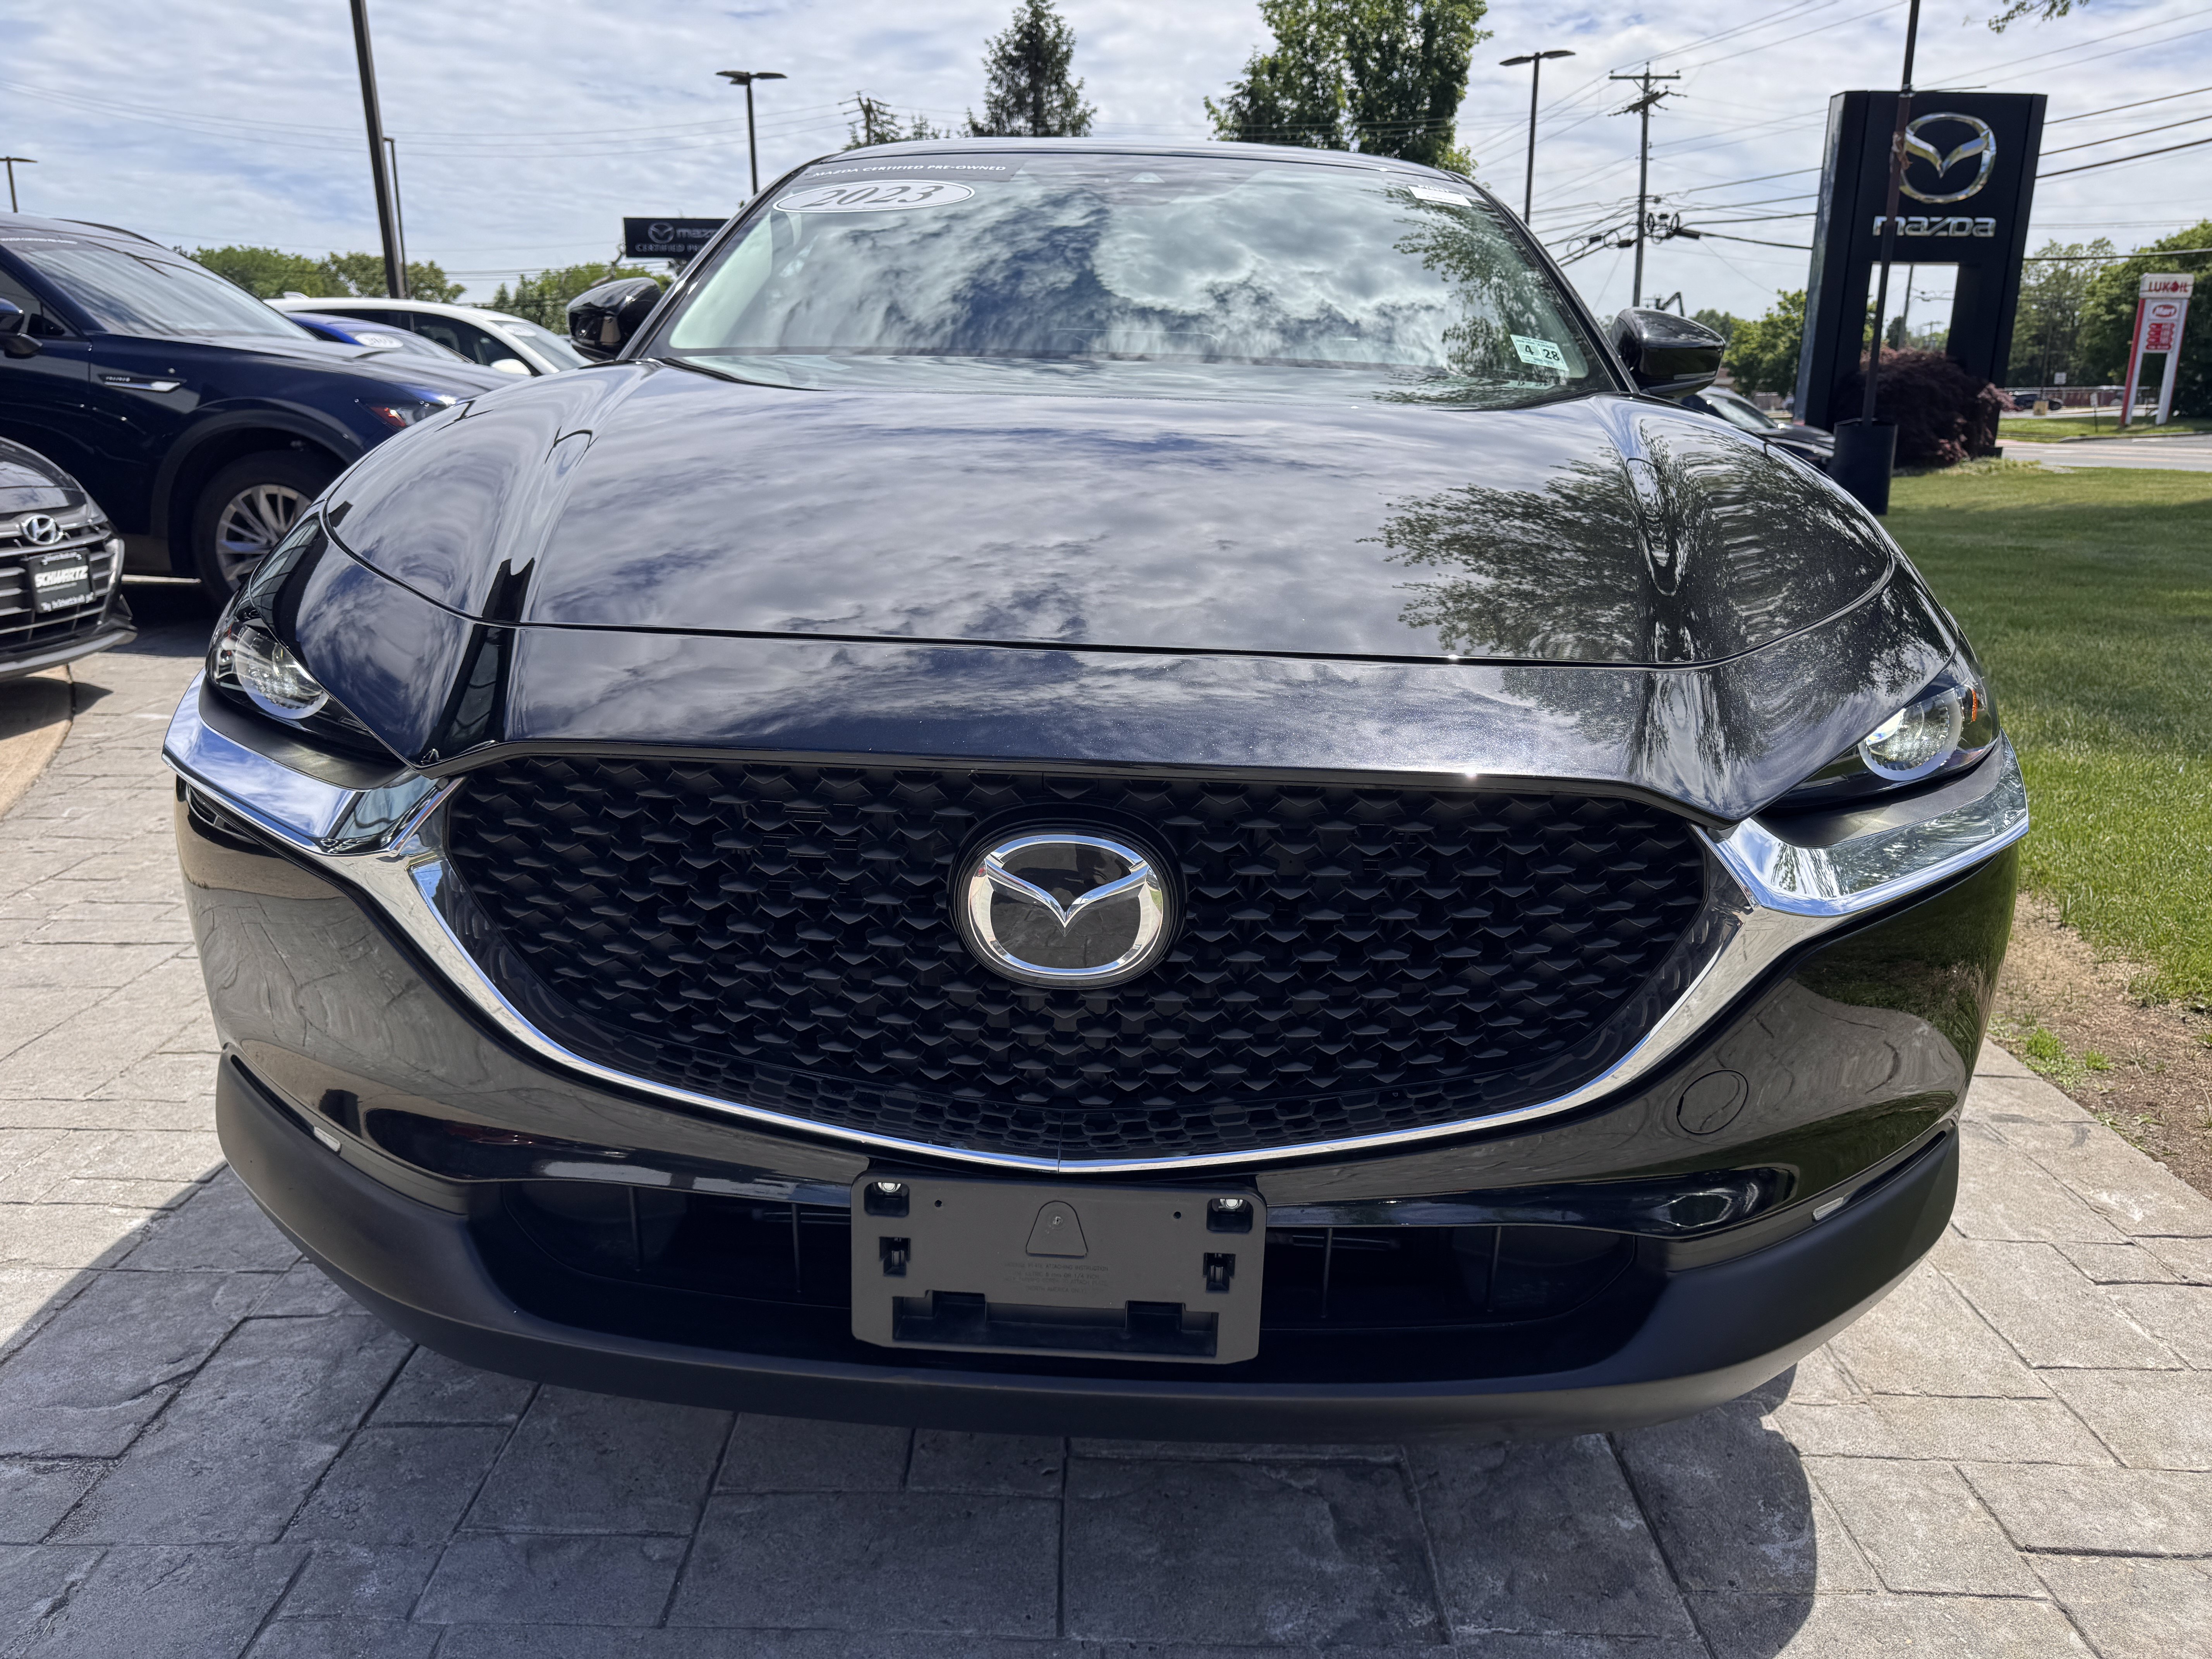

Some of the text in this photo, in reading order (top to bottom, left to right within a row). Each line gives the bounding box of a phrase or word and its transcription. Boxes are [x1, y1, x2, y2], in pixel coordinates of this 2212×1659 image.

[813, 168, 858, 177] MAZDA
[800, 185, 944, 208] 2023
[1872, 216, 1997, 237] mazda
[635, 243, 685, 252] CERTIFIED
[1525, 345, 1560, 361] 4 28
[34, 565, 89, 588] SCHWARTZ
